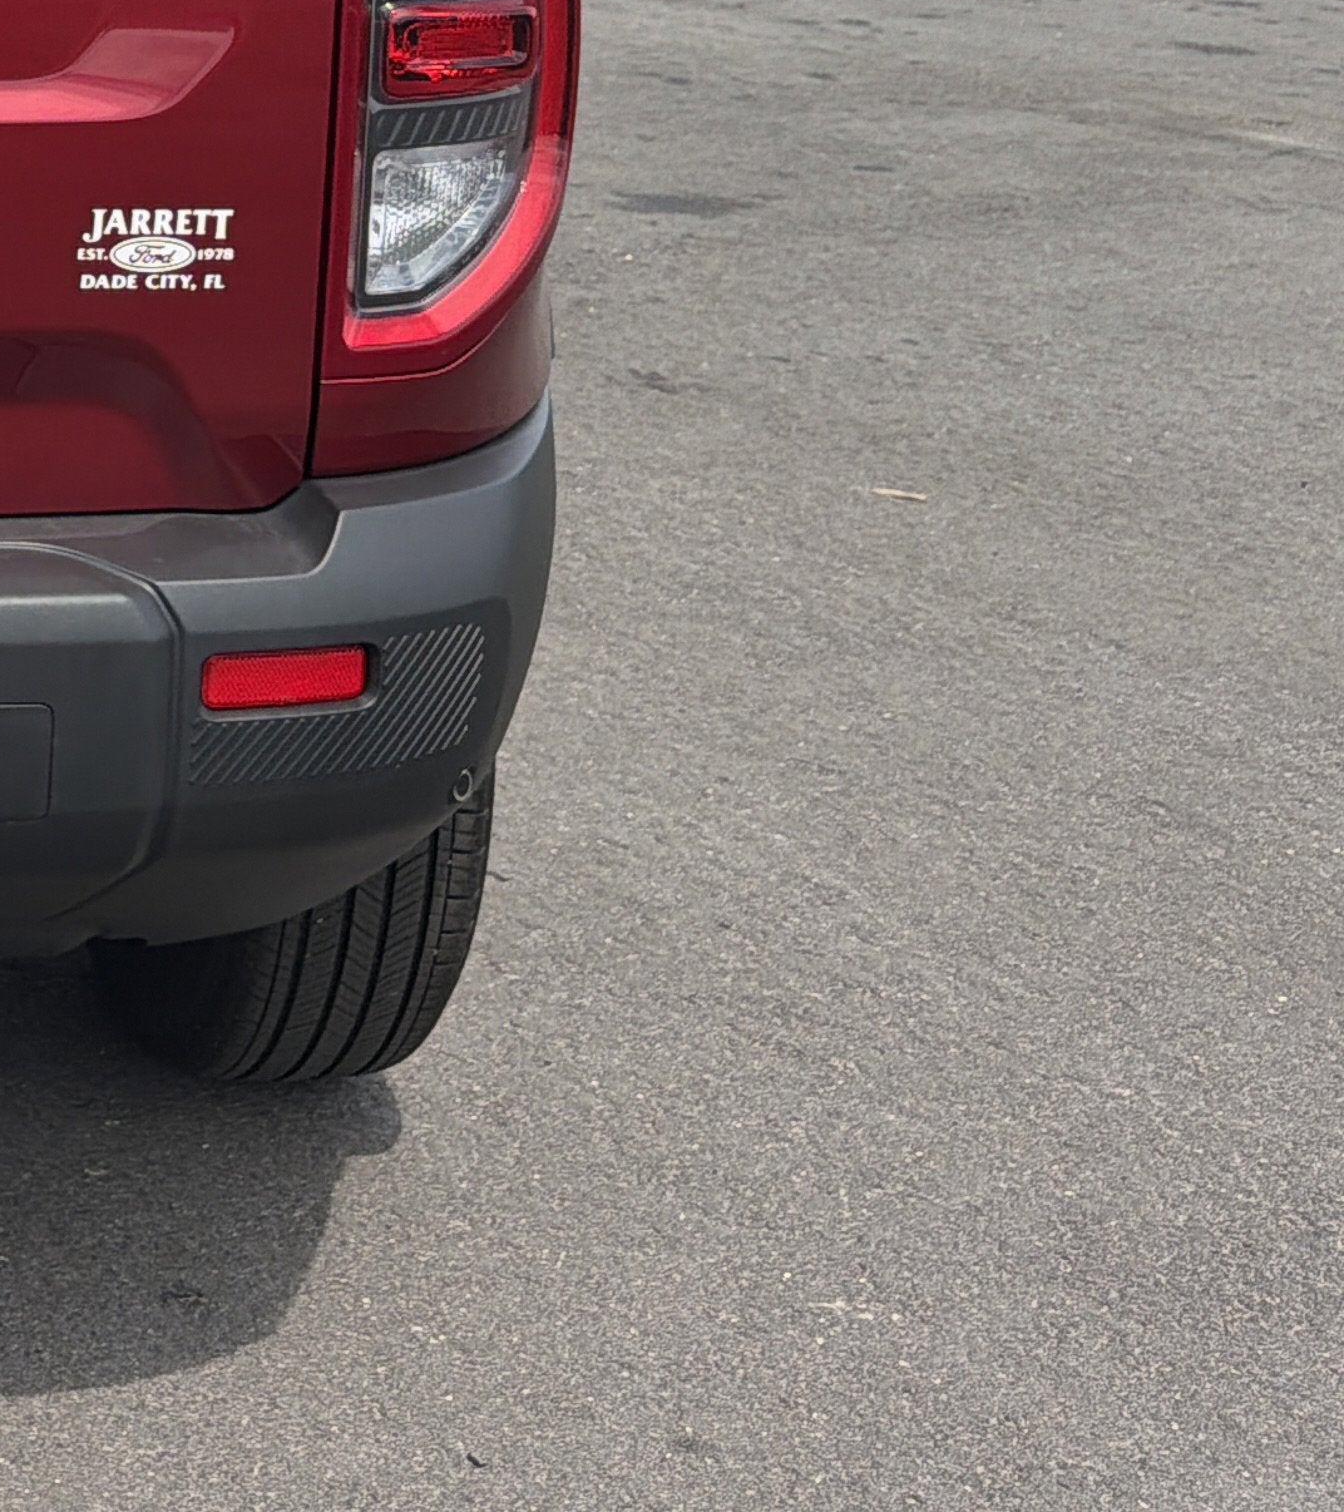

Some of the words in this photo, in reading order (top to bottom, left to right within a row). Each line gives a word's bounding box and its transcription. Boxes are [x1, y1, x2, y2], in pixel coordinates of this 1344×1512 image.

[81, 208, 235, 243] JARRETT
[76, 248, 109, 261] EST.
[128, 244, 177, 264] Ford
[196, 248, 235, 261] 1978
[79, 274, 138, 290] DADE
[144, 274, 197, 291] CITY,
[203, 274, 226, 290] FL
